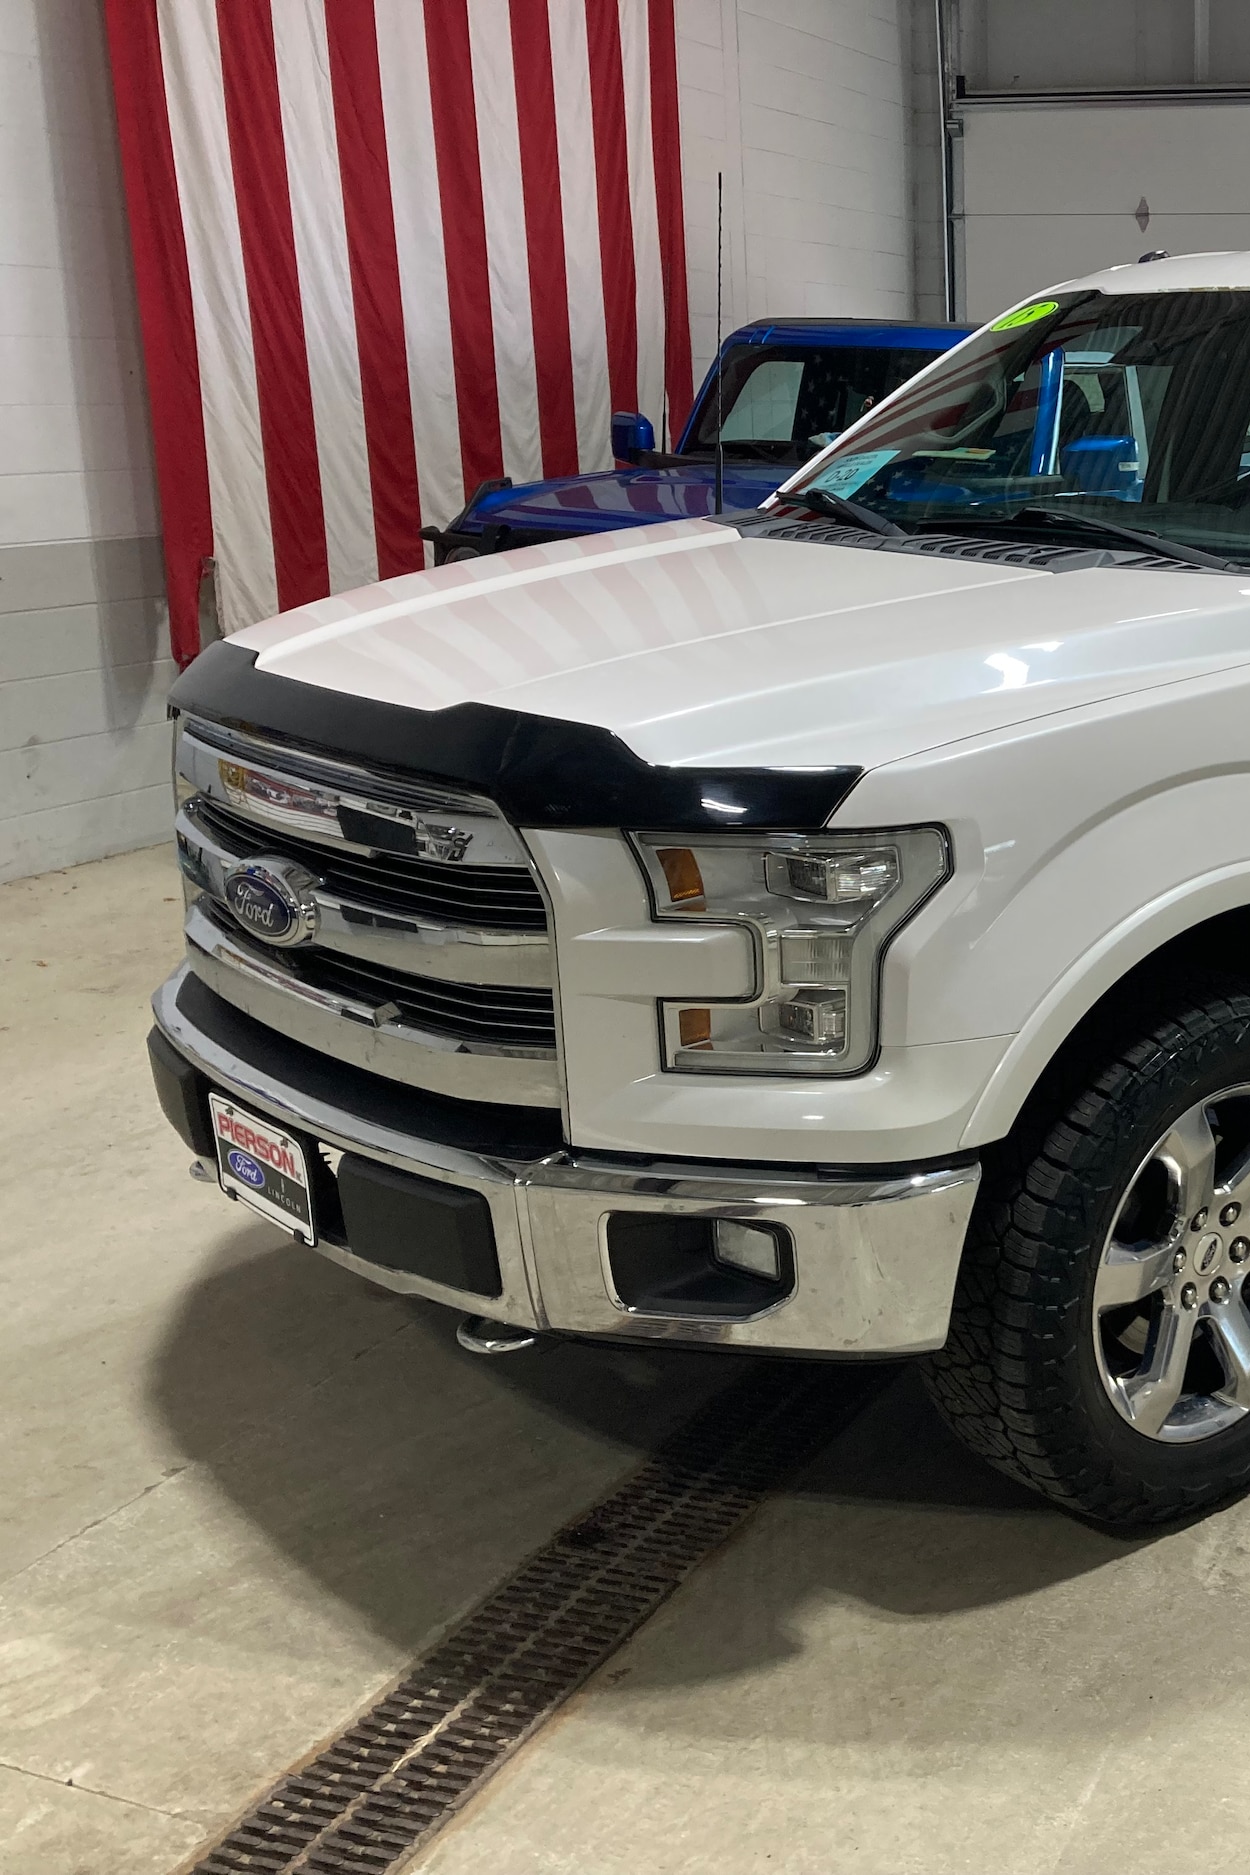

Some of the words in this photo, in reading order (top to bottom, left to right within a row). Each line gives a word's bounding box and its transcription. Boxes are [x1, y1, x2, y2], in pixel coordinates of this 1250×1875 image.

[234, 881, 275, 927] Ford
[216, 1112, 296, 1179] PIERSON
[235, 1155, 259, 1182] Ford
[267, 1186, 302, 1214] LINCOLN
